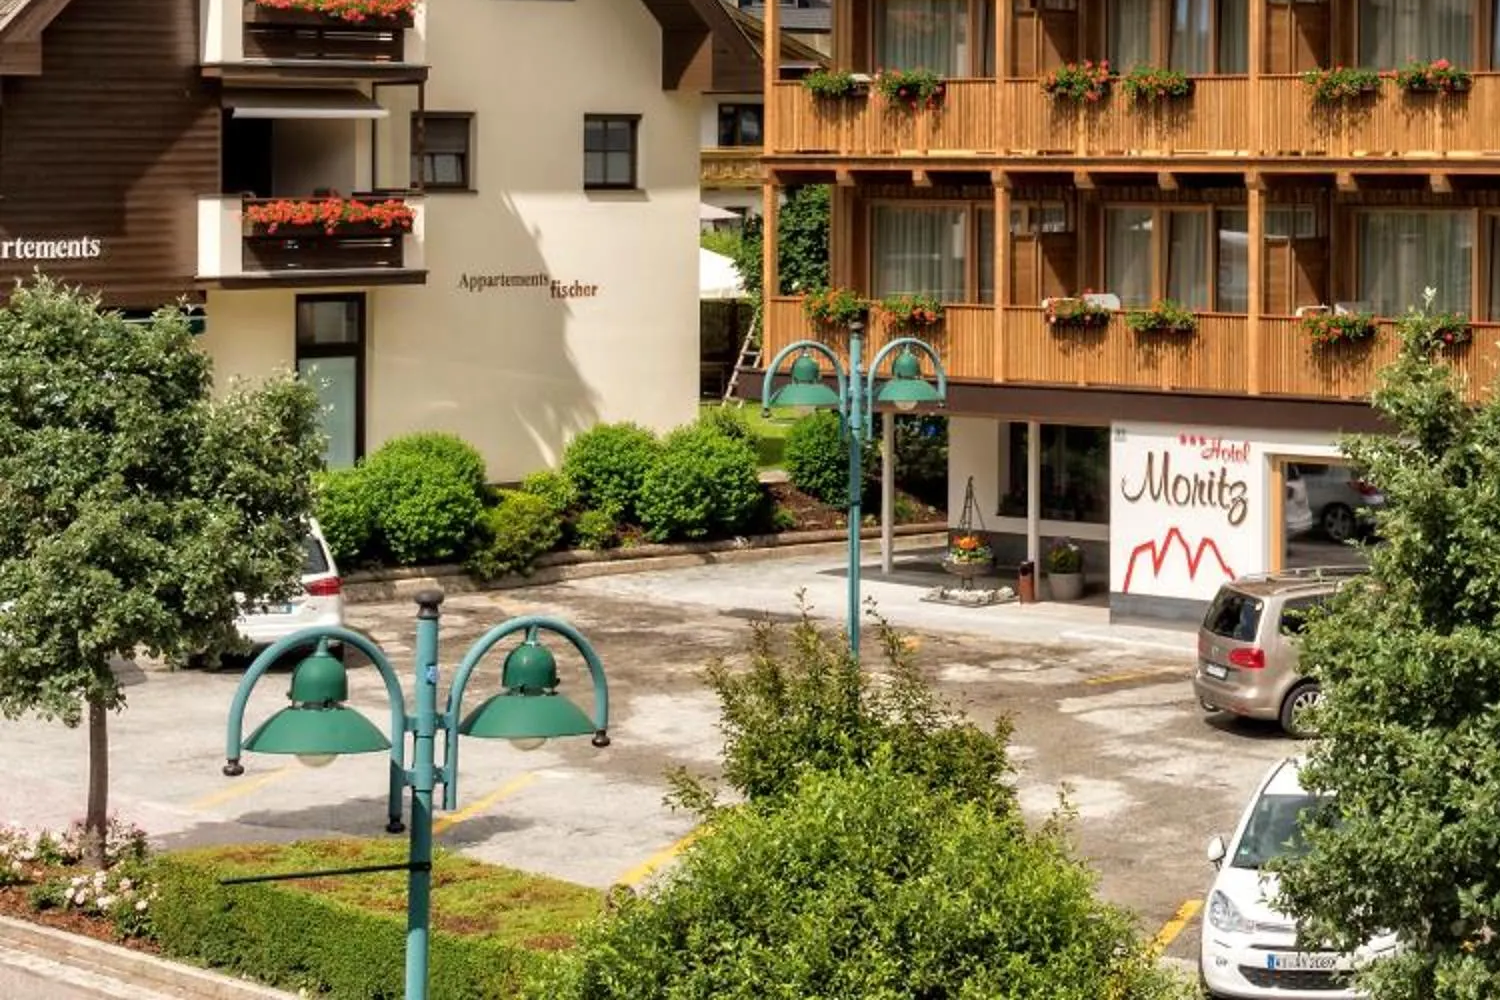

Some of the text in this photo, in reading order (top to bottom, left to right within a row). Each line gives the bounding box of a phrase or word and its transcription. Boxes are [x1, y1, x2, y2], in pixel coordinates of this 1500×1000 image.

[0, 236, 101, 259] rtements
[458, 272, 598, 298] Appartements fischer
[1202, 437, 1251, 463] Hotel
[1121, 451, 1249, 526] Moritz
